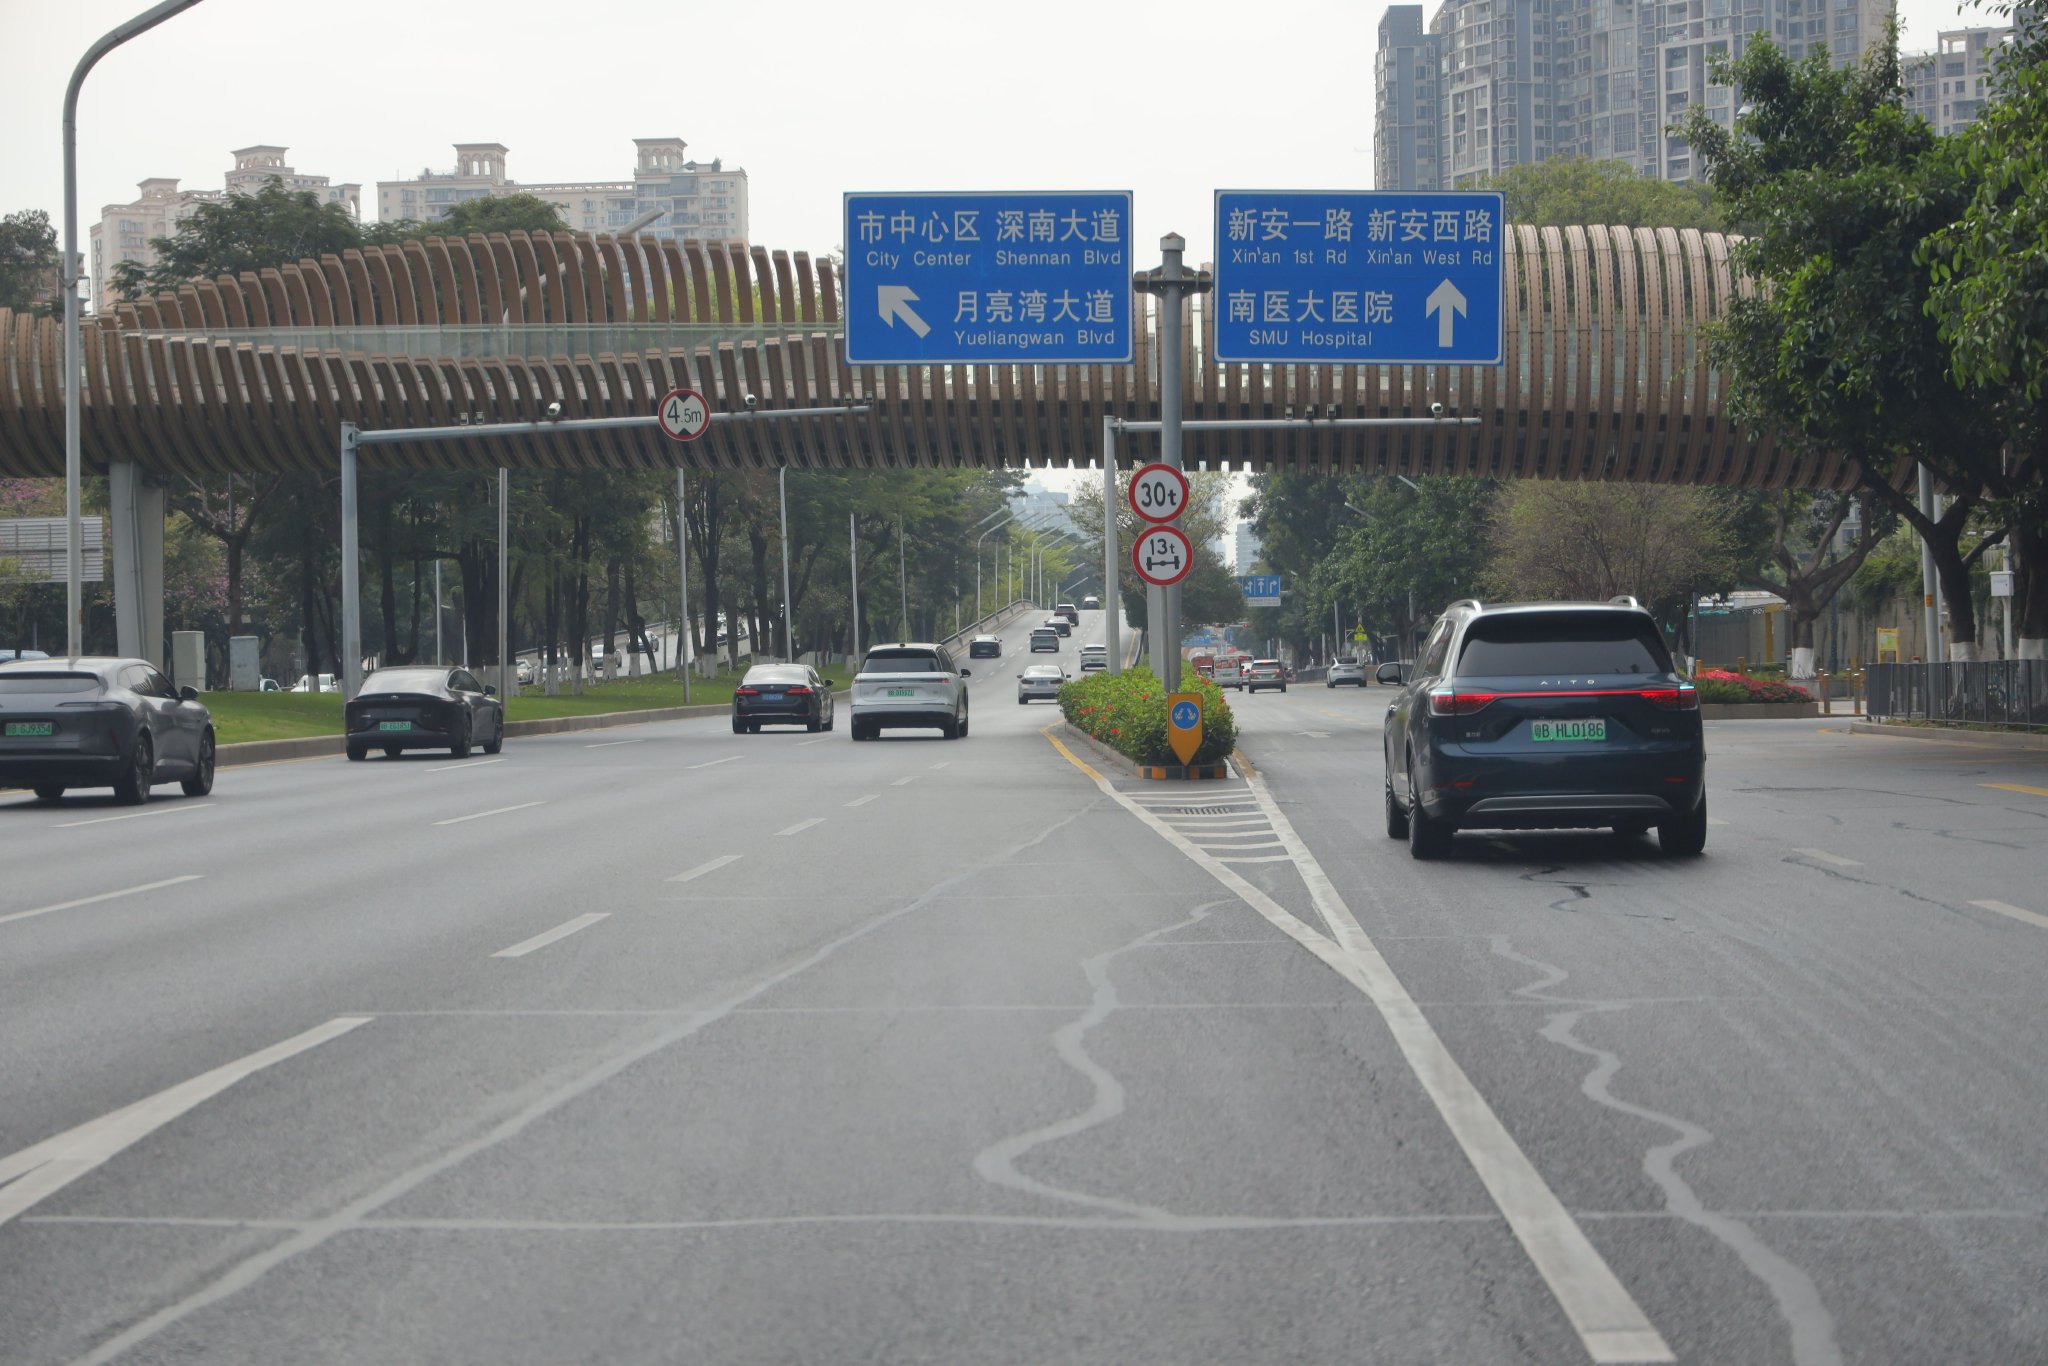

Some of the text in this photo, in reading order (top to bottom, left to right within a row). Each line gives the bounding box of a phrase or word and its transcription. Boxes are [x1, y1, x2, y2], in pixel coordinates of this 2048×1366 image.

[857, 208, 1120, 244] 市中心区 深南大道
[1228, 207, 1493, 243] 新安一路 新安西路
[866, 250, 1121, 270] City Center Shennan Blvd
[1232, 246, 1492, 265] Xin'an 1st Rd Xin'an West Rd
[954, 289, 1115, 323] 月亮湾大道
[1228, 289, 1393, 324] 南医大医院
[954, 329, 1115, 348] Yueliangwan Blvd
[1249, 330, 1372, 349] SMU Hospital
[667, 400, 702, 424] 4.5m
[1141, 482, 1177, 507] 30t
[1150, 538, 1175, 555] 13t
